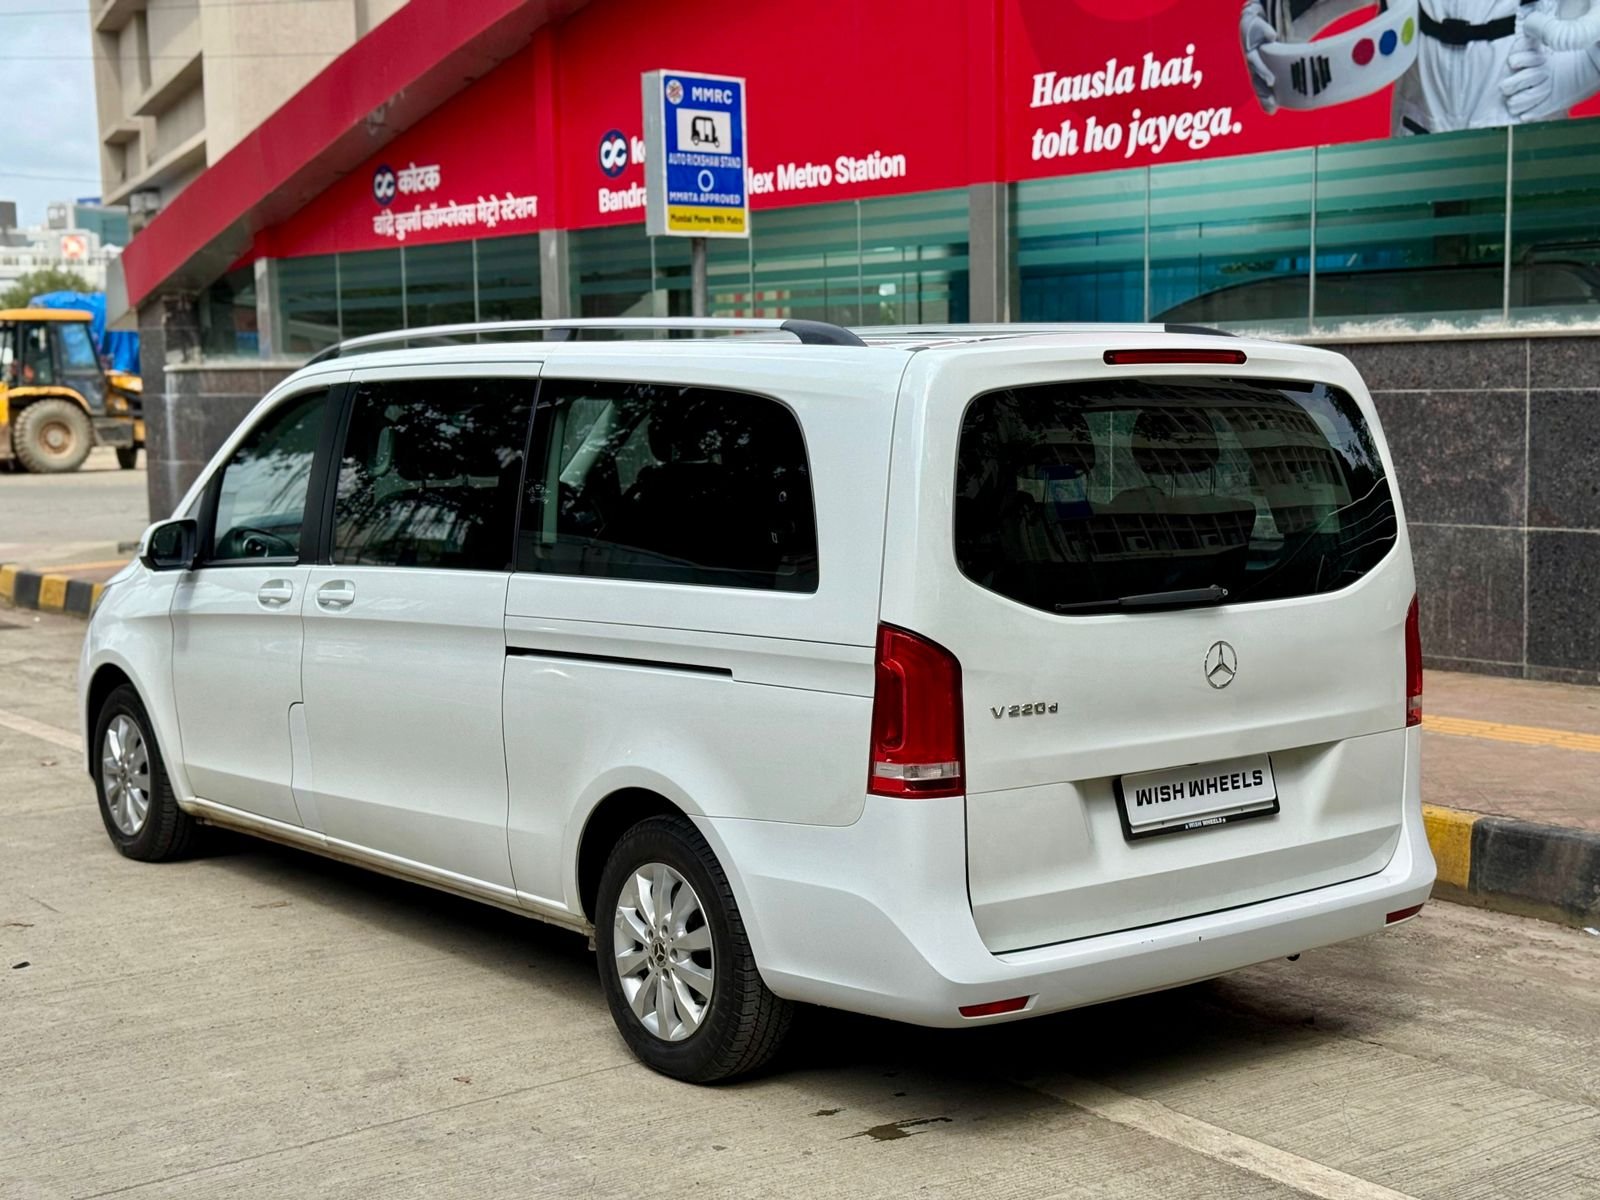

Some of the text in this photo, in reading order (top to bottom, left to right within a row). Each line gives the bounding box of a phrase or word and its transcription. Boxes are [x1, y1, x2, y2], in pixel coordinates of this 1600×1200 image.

[1030, 43, 1202, 108] Hausla hai,
[691, 86, 733, 105] MMRC
[1031, 106, 1242, 160] toh ho jayega.
[668, 152, 686, 165] AUTO
[720, 155, 741, 169] STAND
[748, 166, 775, 195] lex
[776, 157, 833, 192] Metro
[835, 145, 906, 184] Station
[397, 162, 441, 194] कोटक
[500, 191, 538, 221] स्टेशन
[700, 192, 741, 205] APPROVED
[1136, 769, 1263, 807] WISH WHEELS
